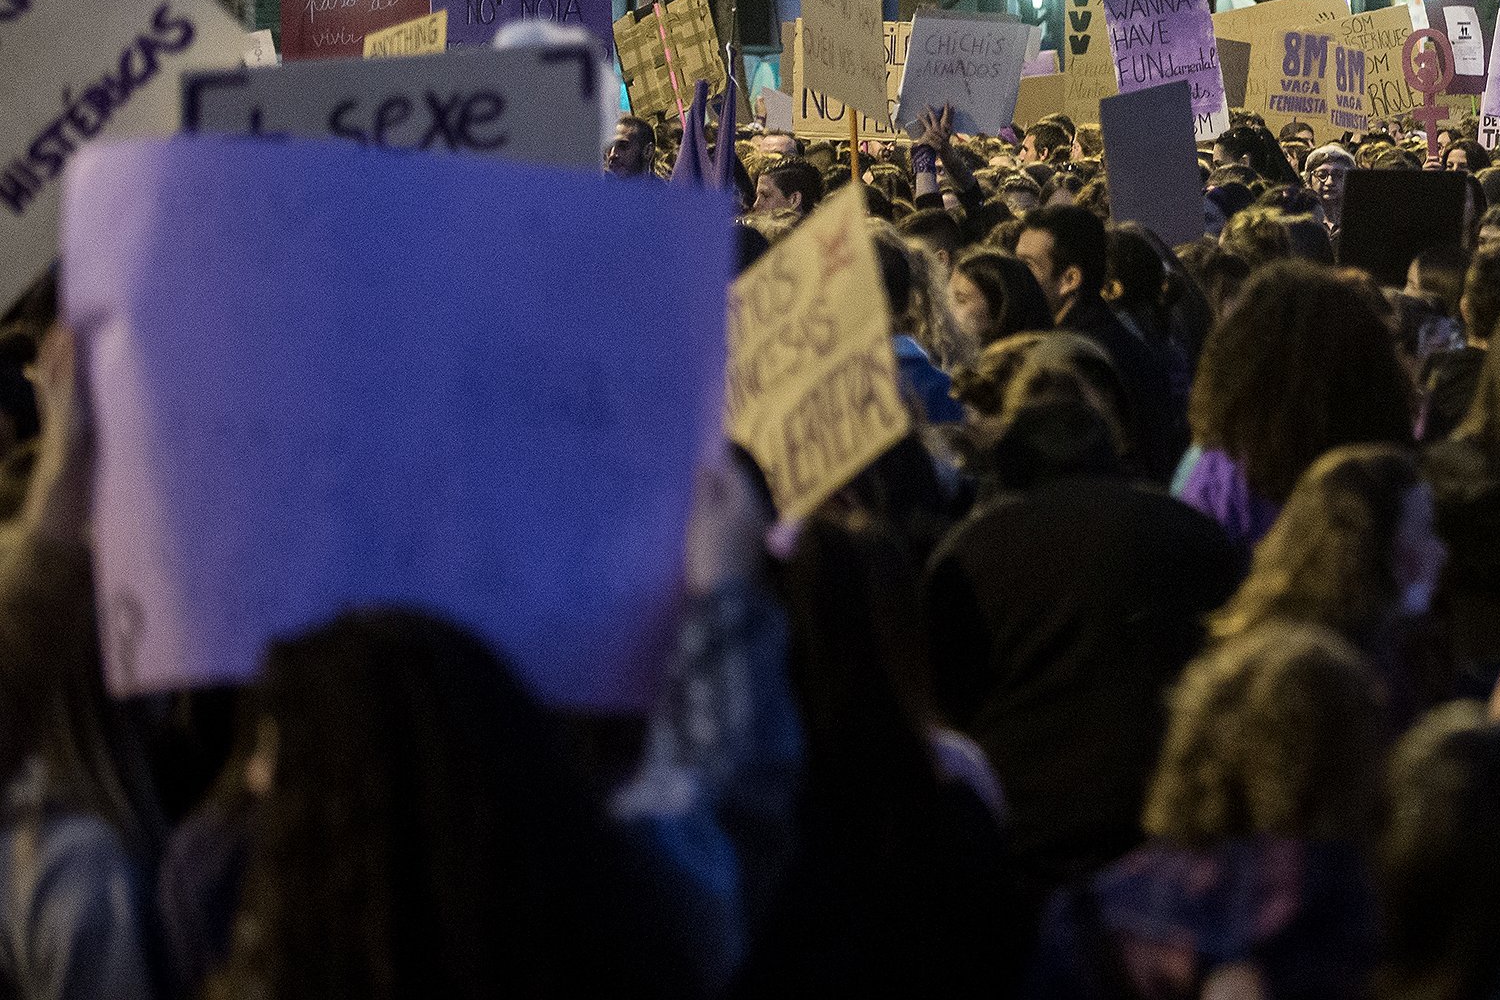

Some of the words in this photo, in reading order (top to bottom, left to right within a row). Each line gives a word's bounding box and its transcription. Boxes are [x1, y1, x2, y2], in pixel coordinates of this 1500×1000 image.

[1112, 18, 1171, 51] HAVE
[1340, 15, 1375, 36] SOM
[1281, 31, 1329, 79] 8M
[1335, 46, 1366, 96] 8M
[1279, 79, 1321, 95] VAGA
[1269, 94, 1328, 115] FEMINISTA
[1335, 94, 1363, 111] VAGA
[328, 89, 506, 151] sexe
[1330, 108, 1369, 129] FEMINISTA
